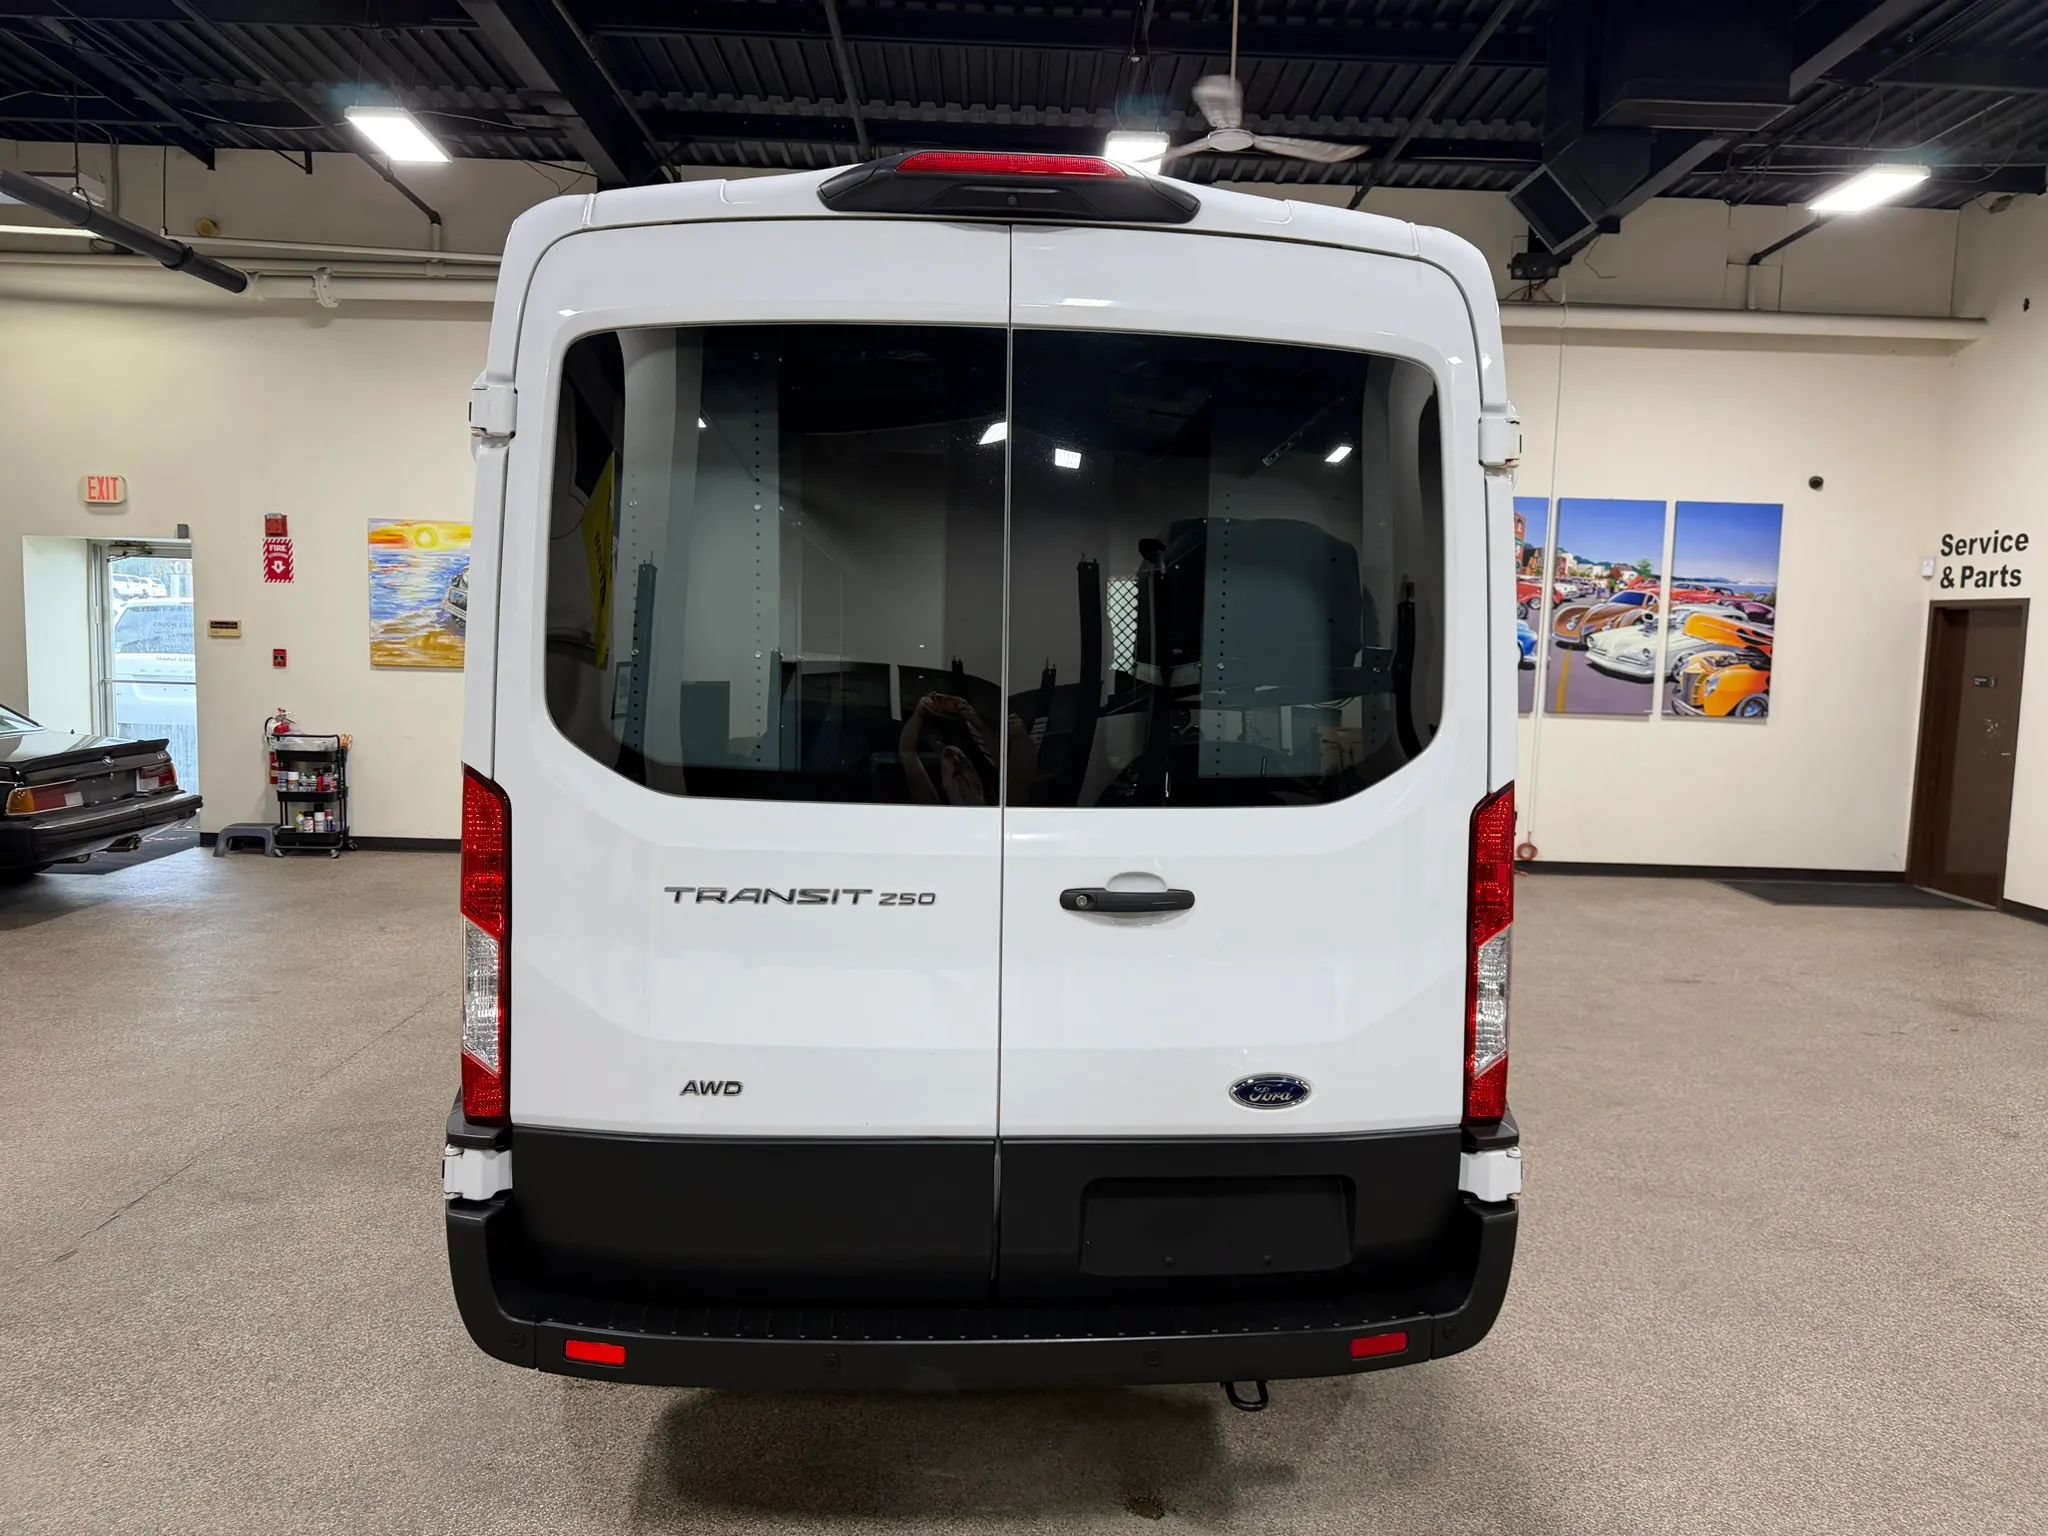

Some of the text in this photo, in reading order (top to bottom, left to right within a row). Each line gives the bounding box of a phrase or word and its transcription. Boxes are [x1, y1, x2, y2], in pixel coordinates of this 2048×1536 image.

[88, 476, 118, 501] EXIT
[268, 544, 288, 552] FIRE
[1940, 529, 2029, 557] Service
[1940, 564, 2022, 589] & Parts
[664, 886, 936, 906] TRANSIT 250
[679, 1080, 744, 1096] AWD
[1249, 1083, 1296, 1102] Ford
